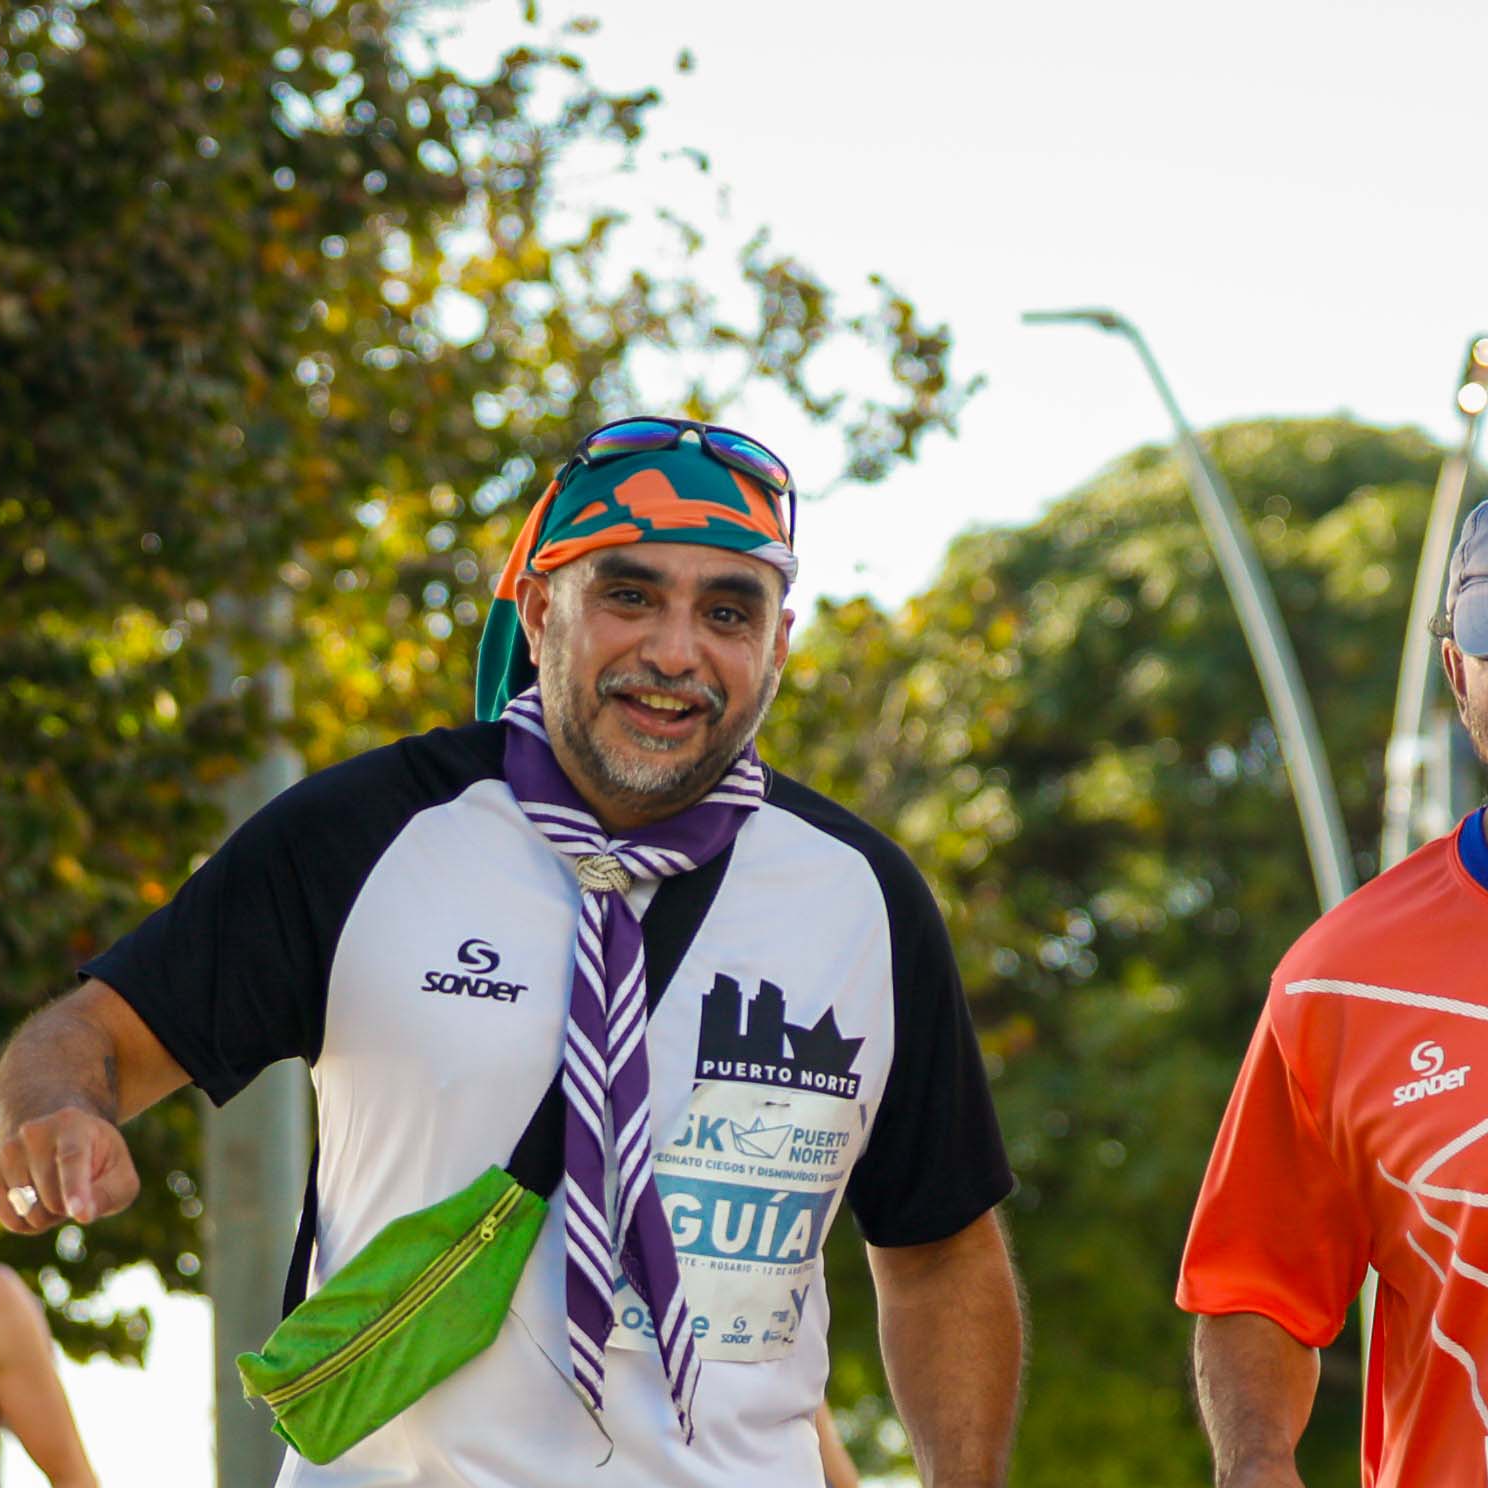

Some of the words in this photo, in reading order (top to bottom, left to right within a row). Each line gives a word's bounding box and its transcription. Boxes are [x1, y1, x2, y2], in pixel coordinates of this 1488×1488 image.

[702, 1060, 793, 1083] PUERTO
[800, 1070, 857, 1096] NORTE
[792, 1127, 850, 1148] PUERTO
[789, 1148, 840, 1165] NORTE
[705, 1160, 745, 1173] CIEGOS
[748, 1165, 756, 1175] Y
[662, 1191, 813, 1259] GUÍA
